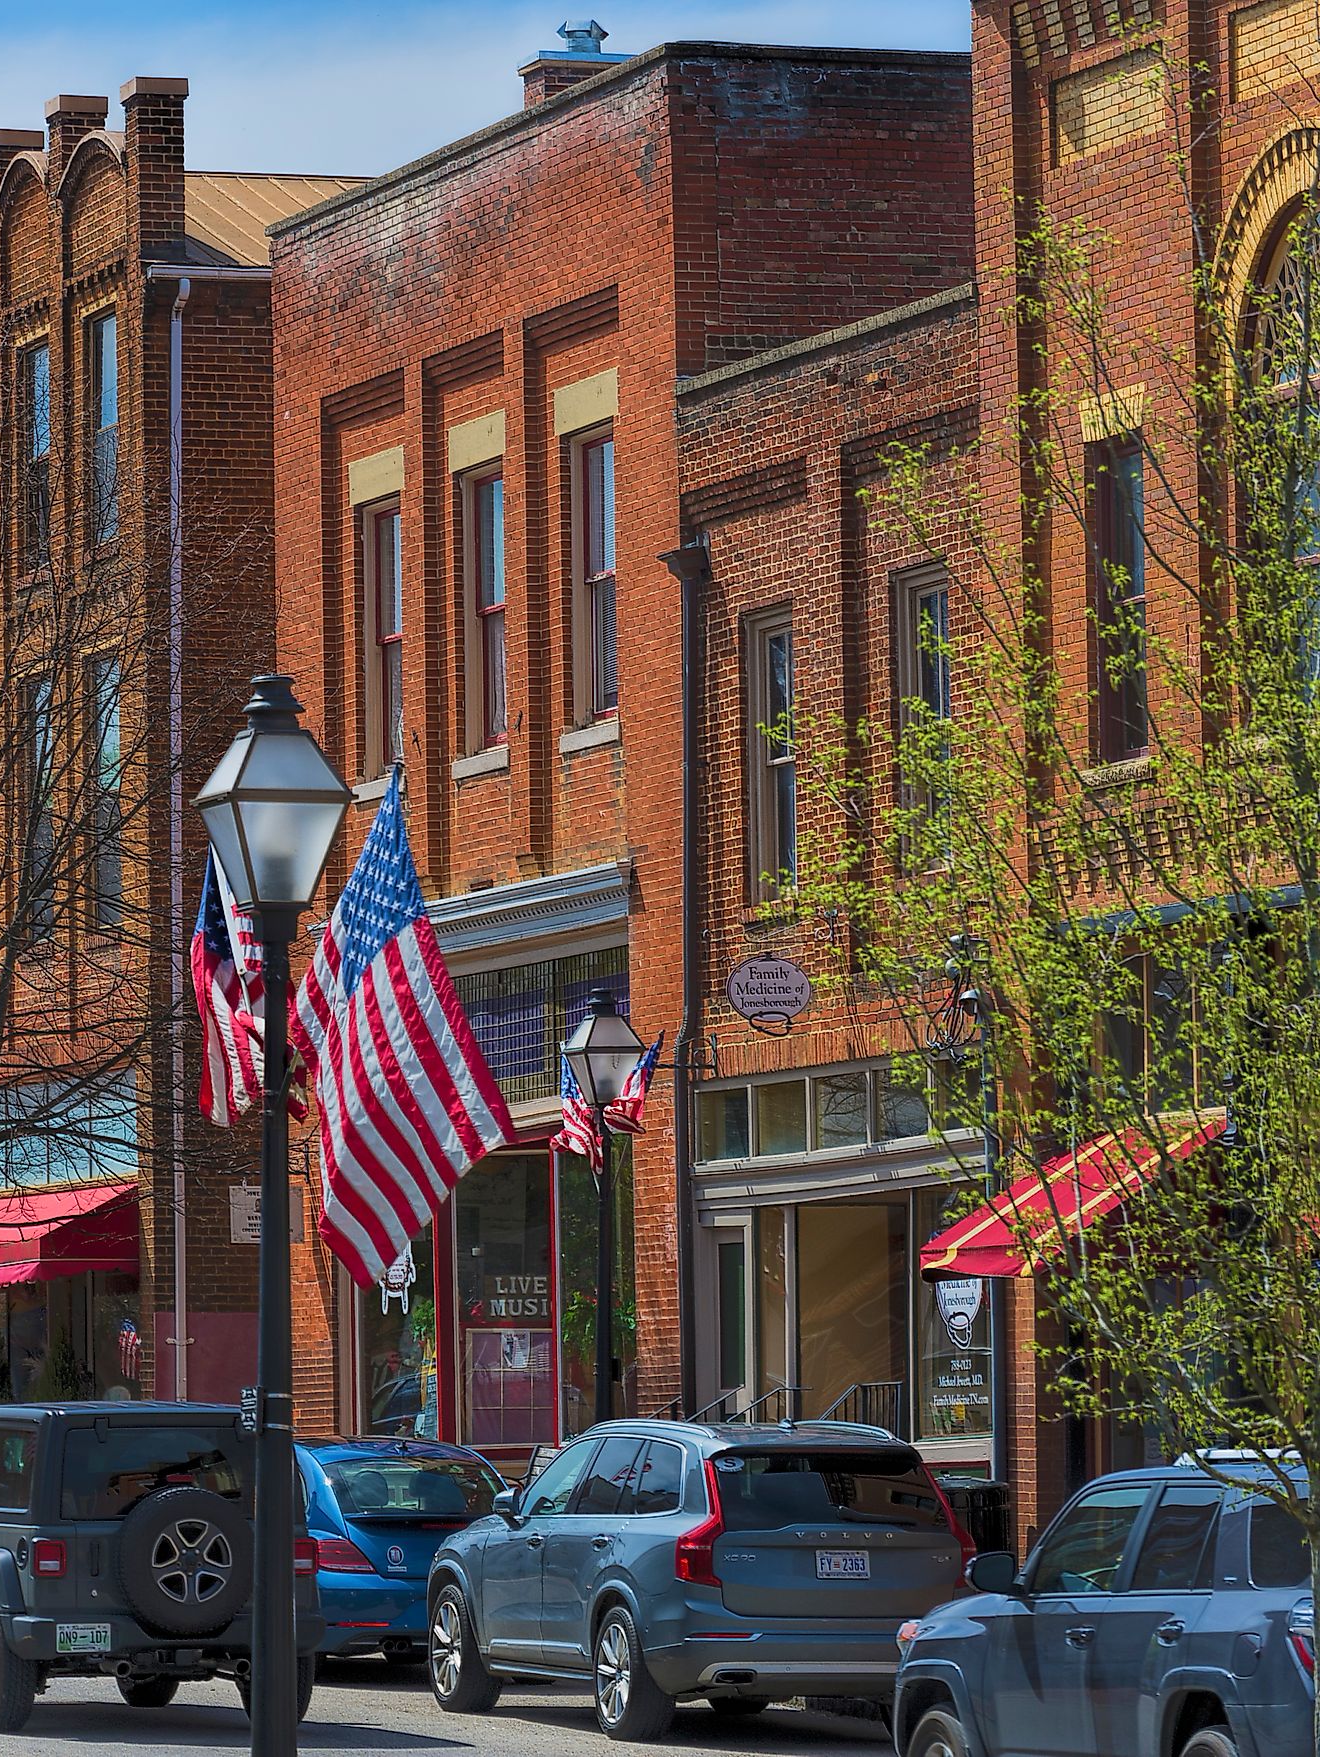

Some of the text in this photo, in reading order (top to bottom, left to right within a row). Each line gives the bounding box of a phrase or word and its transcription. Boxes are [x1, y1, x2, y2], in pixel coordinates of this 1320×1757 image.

[748, 966, 790, 981] Family
[735, 982, 805, 996] Medicine of
[740, 997, 802, 1010] Jonesborough
[495, 1276, 548, 1295] LIVE
[490, 1298, 553, 1317] MUSI
[723, 1458, 736, 1468] S
[795, 1531, 893, 1539] VOLVO
[820, 1557, 866, 1572] FY 2363
